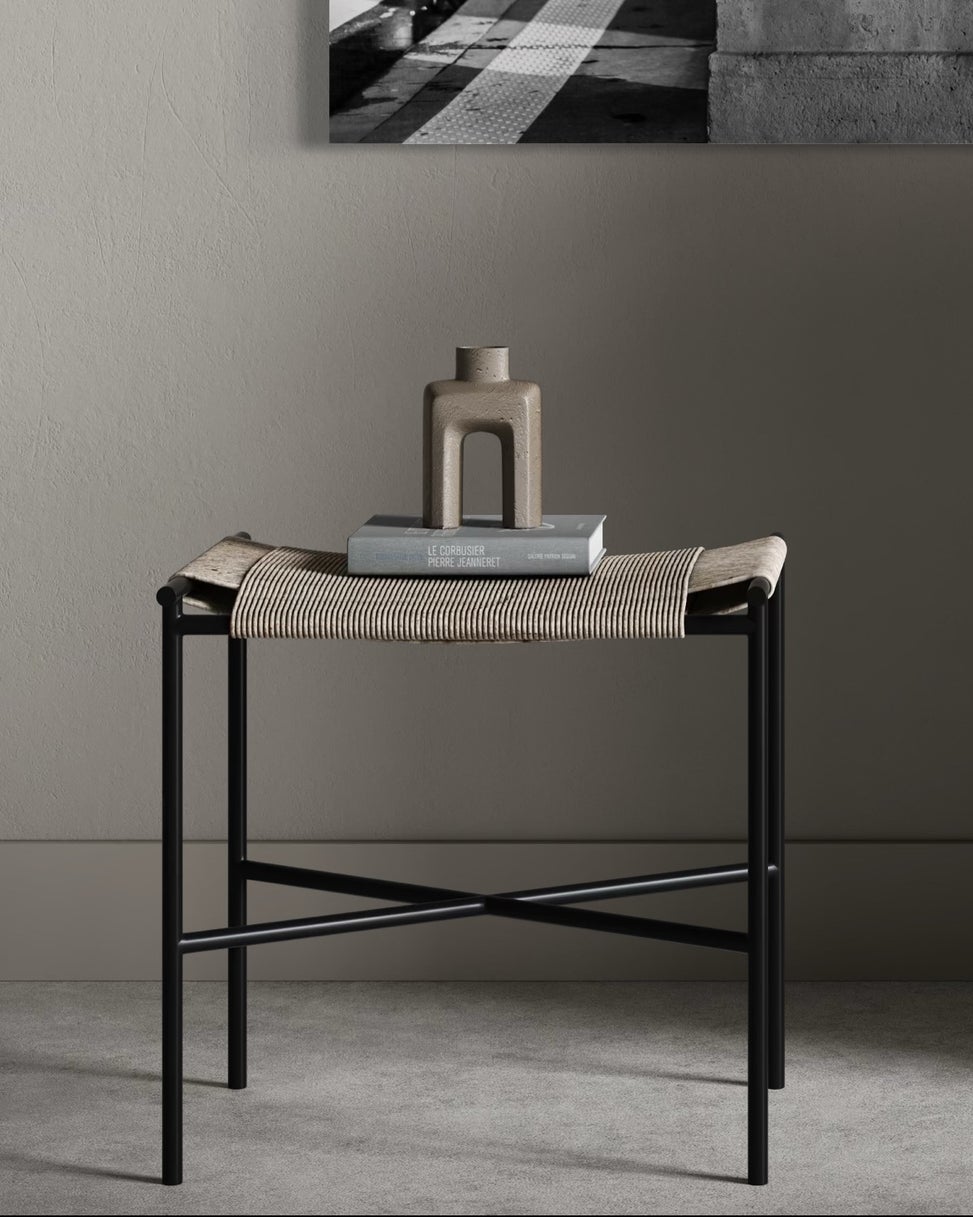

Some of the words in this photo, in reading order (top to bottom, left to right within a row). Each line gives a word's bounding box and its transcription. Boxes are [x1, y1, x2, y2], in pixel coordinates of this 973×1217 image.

[427, 545, 438, 556] LE
[440, 545, 485, 556] CORBUSIER
[427, 557, 455, 568] PIERRE
[456, 557, 501, 568] JEANNERET
